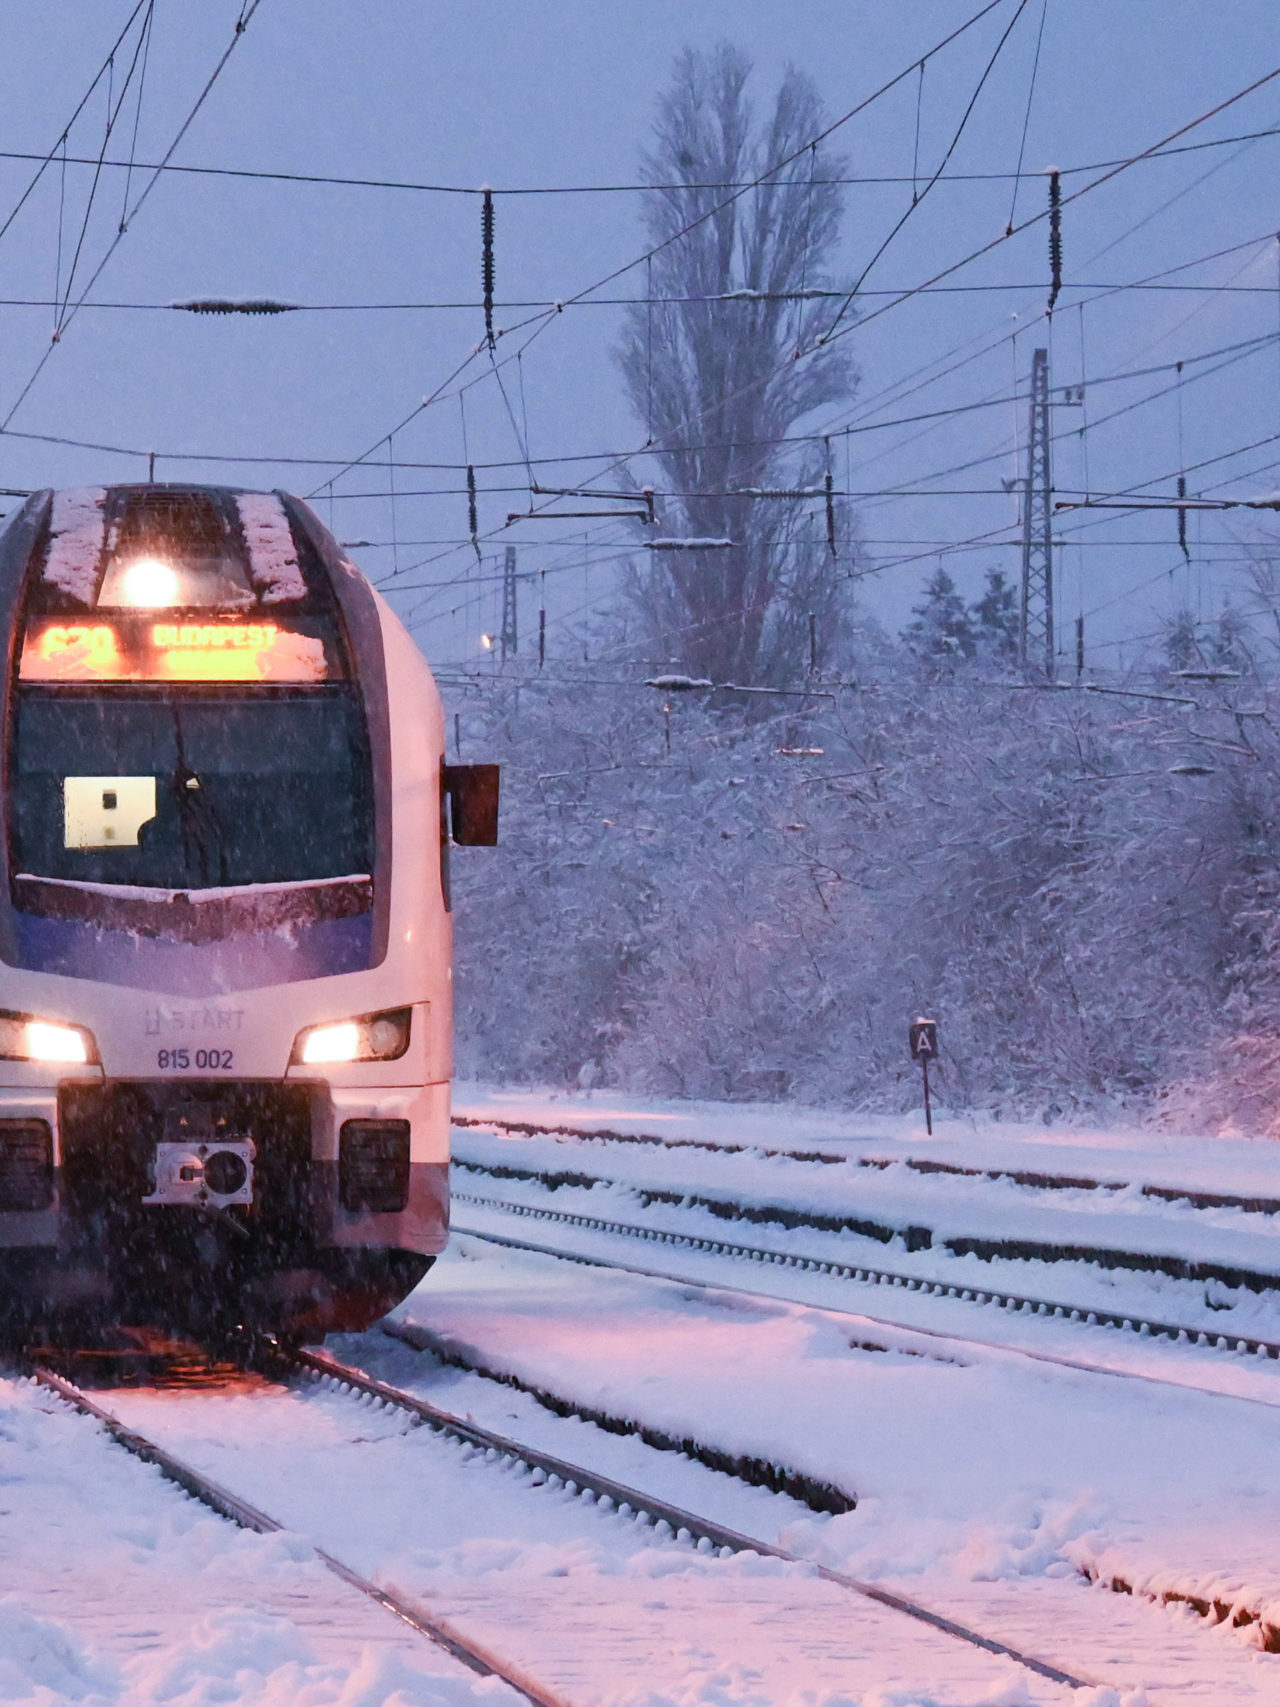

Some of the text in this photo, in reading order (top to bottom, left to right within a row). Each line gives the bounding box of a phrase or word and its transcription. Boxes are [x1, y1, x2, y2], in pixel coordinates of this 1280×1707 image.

[152, 625, 277, 646] BUDAPEST
[157, 1048, 234, 1069] 815 002
